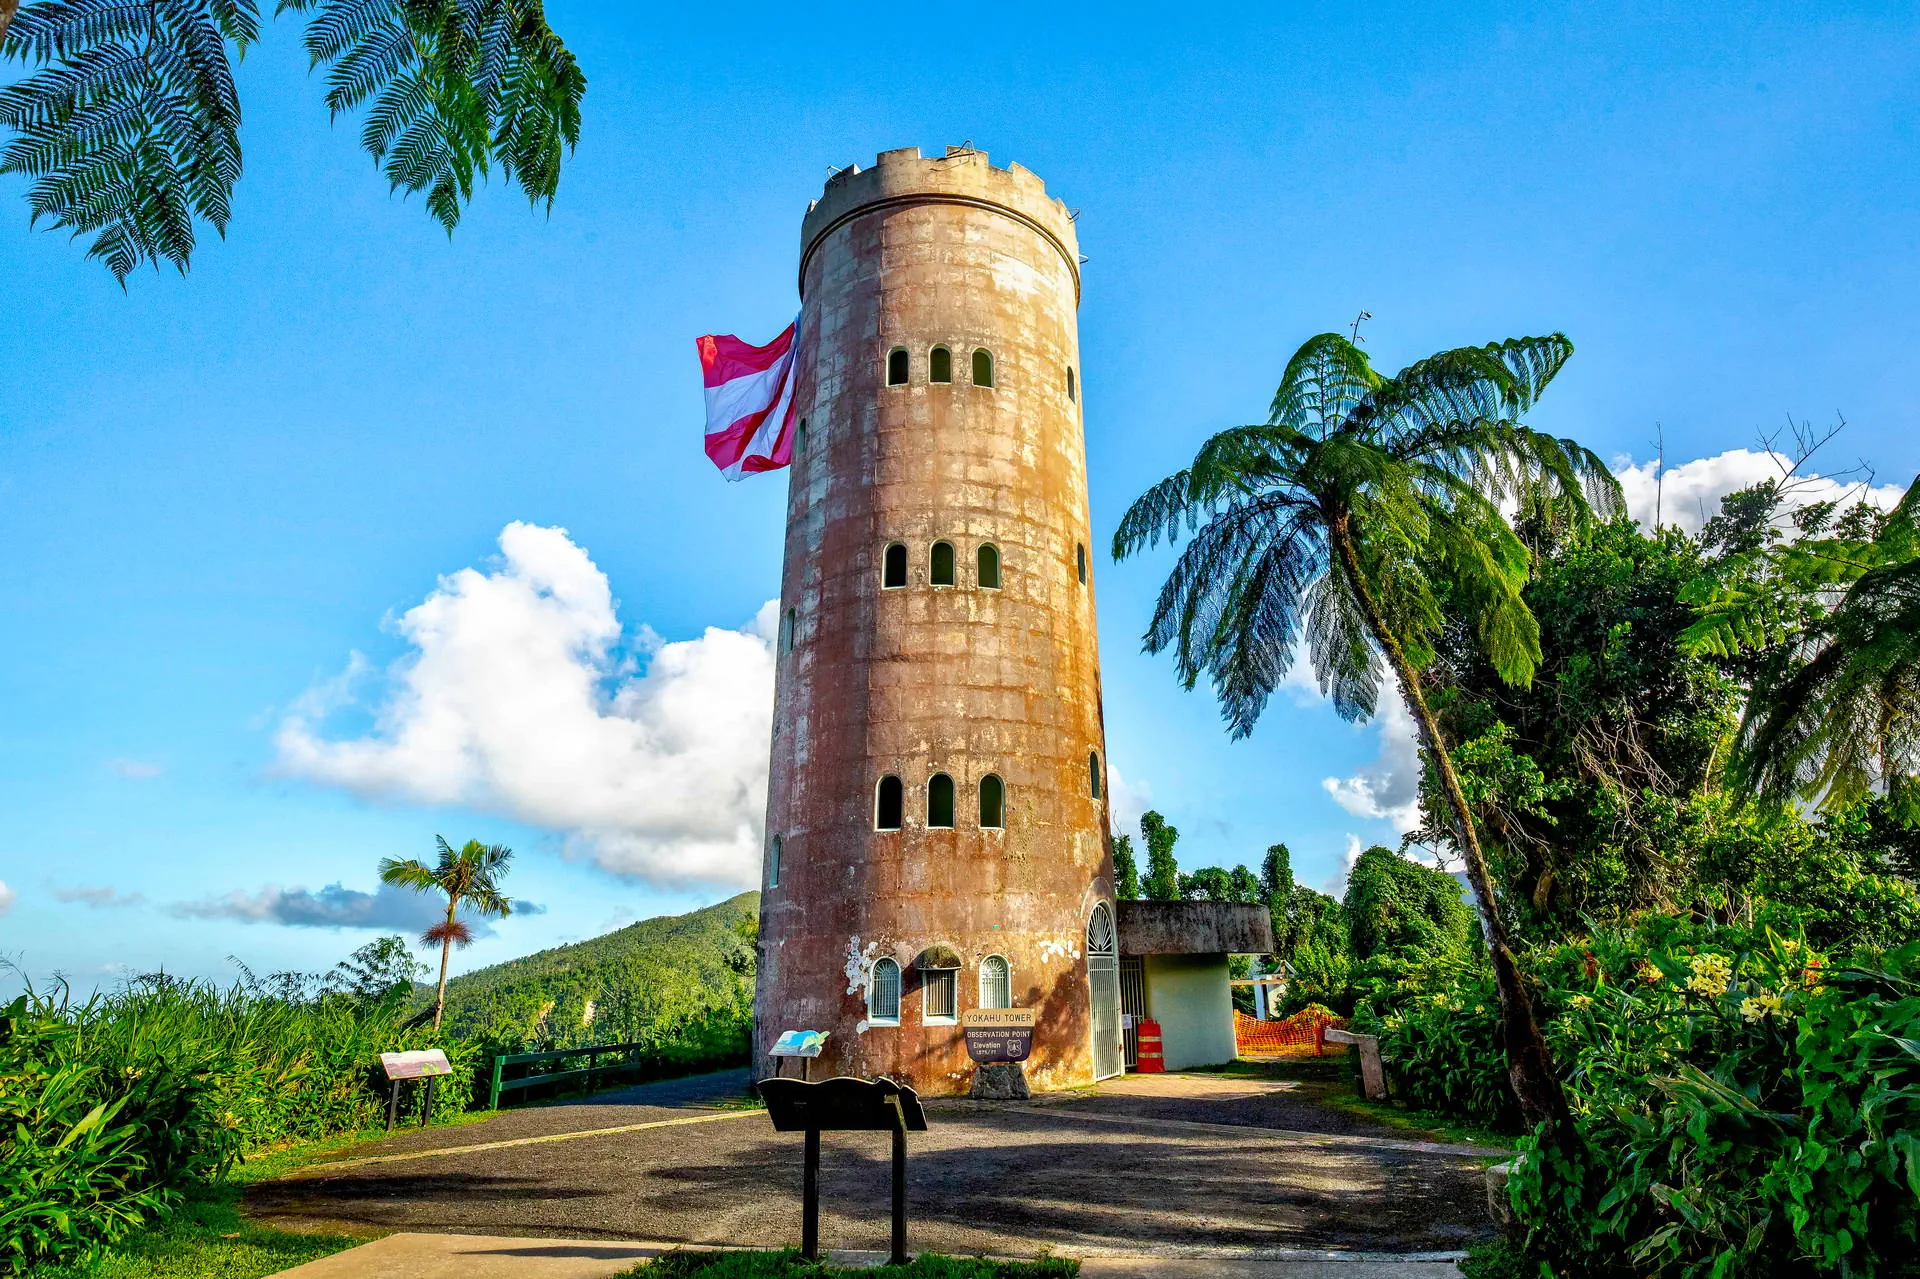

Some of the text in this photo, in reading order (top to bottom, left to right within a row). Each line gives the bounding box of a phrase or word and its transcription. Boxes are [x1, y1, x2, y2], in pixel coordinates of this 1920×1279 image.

[966, 1014, 1032, 1022] YOKAHU TOWER
[973, 1041, 1001, 1049] Elevation
